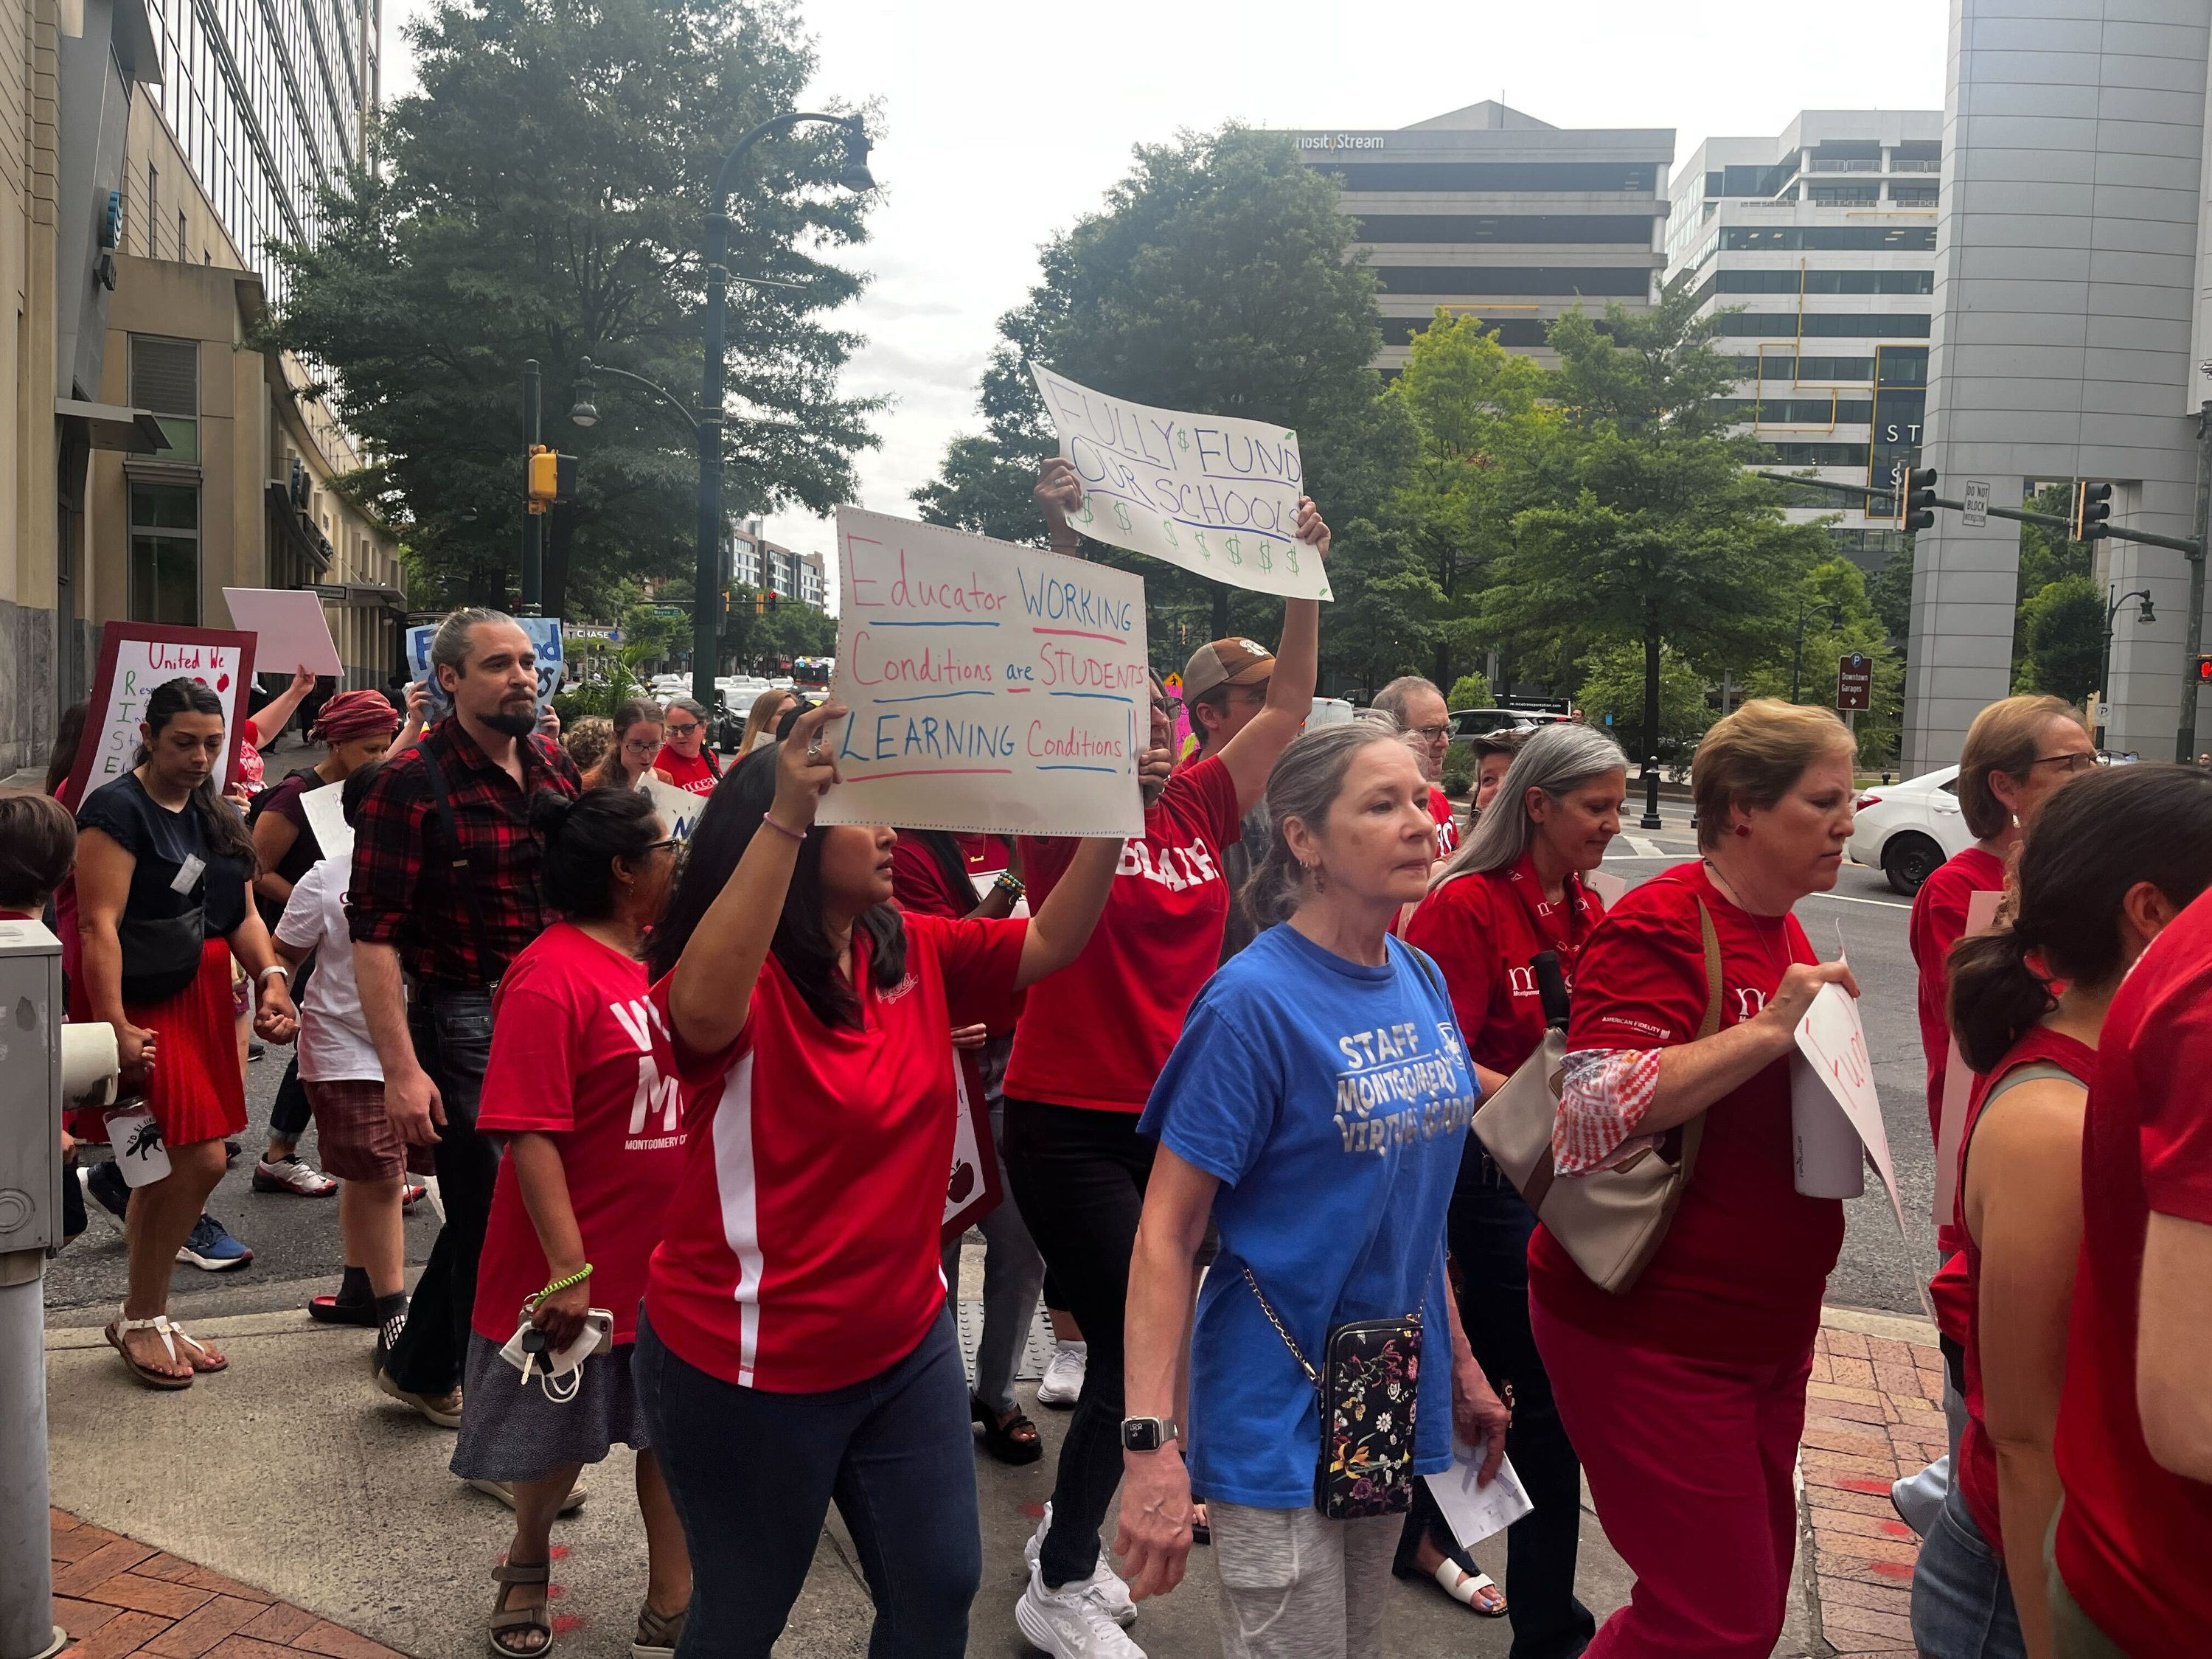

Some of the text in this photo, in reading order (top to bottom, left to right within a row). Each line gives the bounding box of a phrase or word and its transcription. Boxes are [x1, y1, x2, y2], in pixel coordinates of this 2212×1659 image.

[1295, 133, 1384, 154] riosityStream
[1046, 378, 1178, 470] FULLY
[1194, 427, 1301, 484] FUND
[1071, 436, 1156, 507] OUR
[1966, 485, 1989, 498] DO NOT
[1966, 499, 1986, 512] BLOCK
[846, 532, 1132, 632] Educator WORKING
[577, 630, 610, 639] CHASE
[149, 641, 225, 669] United We
[852, 631, 1144, 690] Conditions are STUDENTS
[1841, 684, 1863, 694] Garages
[1842, 672, 1868, 681] Downtown
[839, 711, 1015, 762] LEARNING
[1115, 837, 1220, 893] BLAIR
[1512, 990, 1540, 998] Montgomer
[1601, 1016, 1633, 1026] AMERICAN
[1633, 1020, 1660, 1033] FIDELITY
[1339, 1022, 1419, 1069] STAFF
[1335, 1048, 1457, 1119] MONTGOMERY
[1422, 1095, 1474, 1141] ACADE
[625, 1135, 678, 1150] MONTGOMERY
